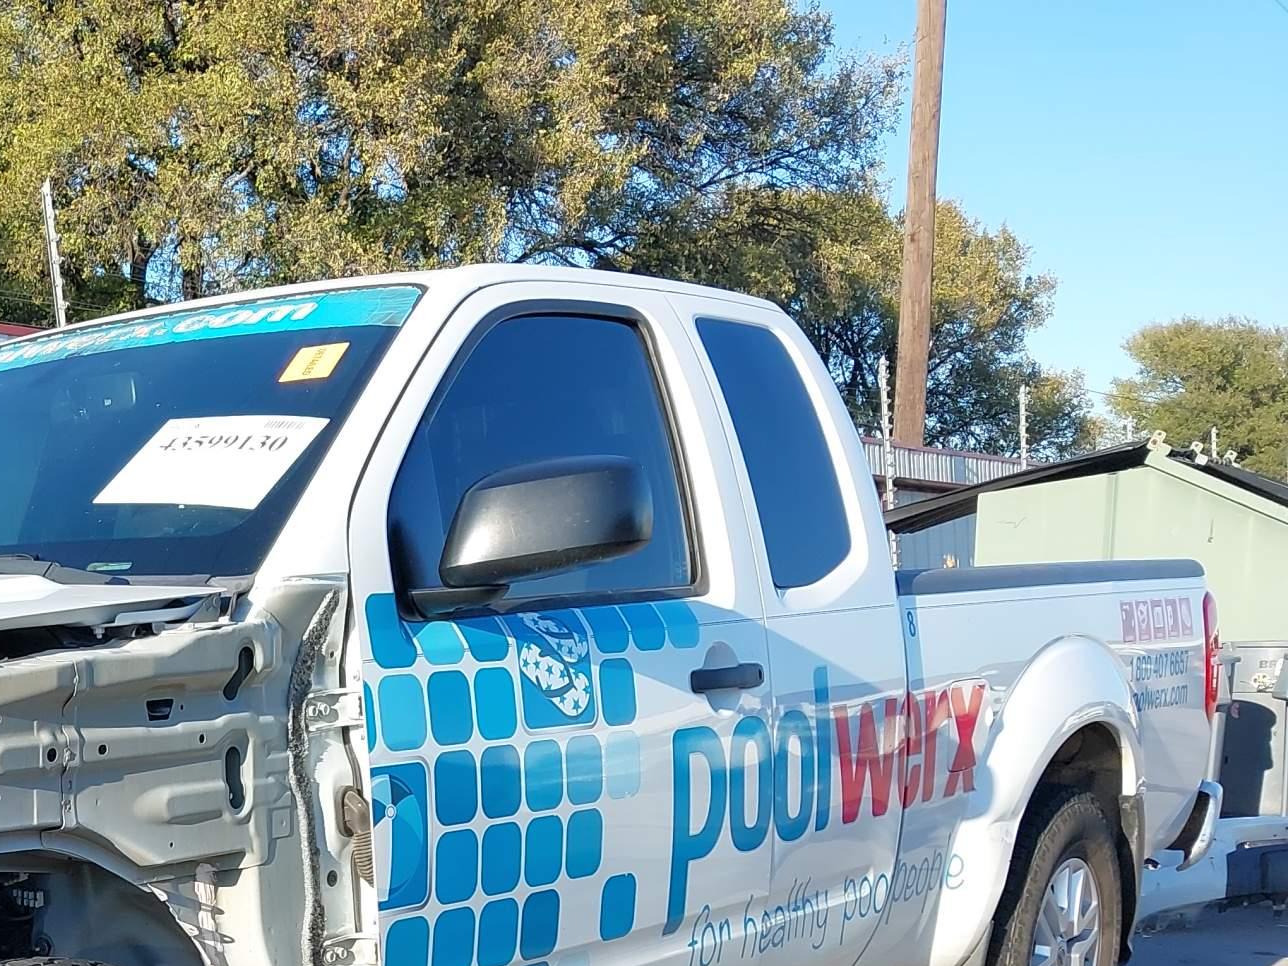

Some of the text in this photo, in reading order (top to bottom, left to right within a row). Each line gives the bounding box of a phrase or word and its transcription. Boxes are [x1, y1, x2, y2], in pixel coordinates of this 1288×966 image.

[160, 435, 288, 451] 43599130
[907, 611, 917, 637] 8
[663, 666, 986, 936] poolwerx
[740, 876, 829, 959] healthy
[885, 832, 965, 925] people
